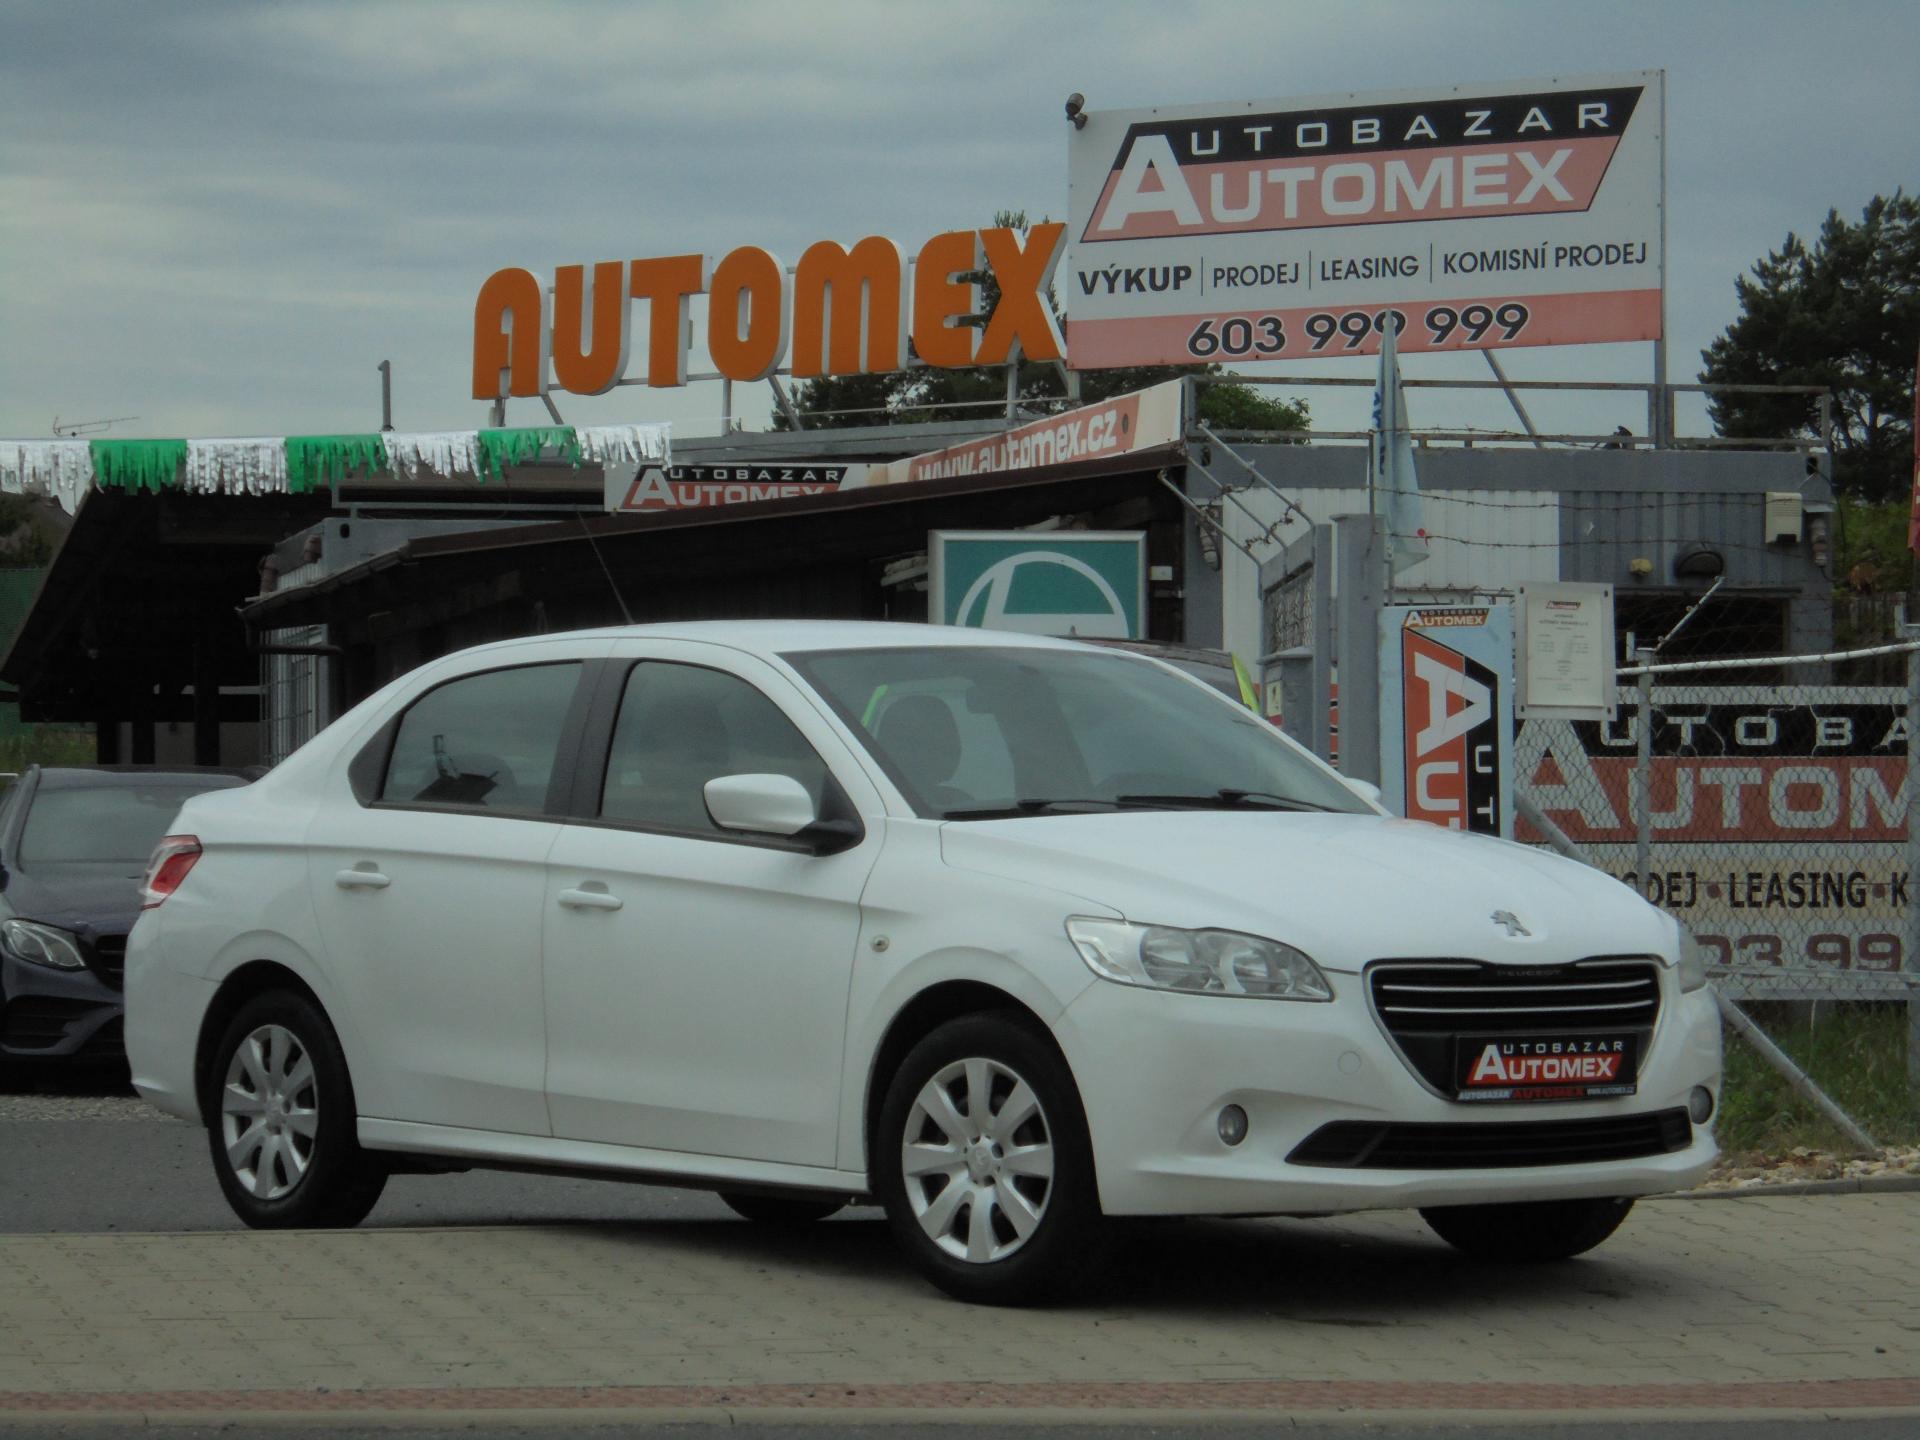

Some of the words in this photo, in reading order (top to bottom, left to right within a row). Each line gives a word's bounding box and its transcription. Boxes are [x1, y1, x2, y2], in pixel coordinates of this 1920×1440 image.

[1098, 134, 1575, 232] AUTOMEX
[1078, 263, 1192, 296] VÝKUP
[1212, 262, 1299, 289] PRODEJ
[1320, 255, 1420, 282] LEASING
[1443, 241, 1549, 275] KOMISNÍ
[1554, 242, 1647, 269] PRODEJ
[472, 222, 1067, 400] AUTOMEX
[1187, 315, 1287, 357] 603
[1304, 309, 1406, 351] 999
[1425, 302, 1530, 345] 999
[1405, 610, 1483, 626] AUTOMEX
[1413, 651, 1492, 832] AU
[1728, 872, 1866, 909] LEASING
[1473, 1044, 1614, 1081] AUTOMEX
